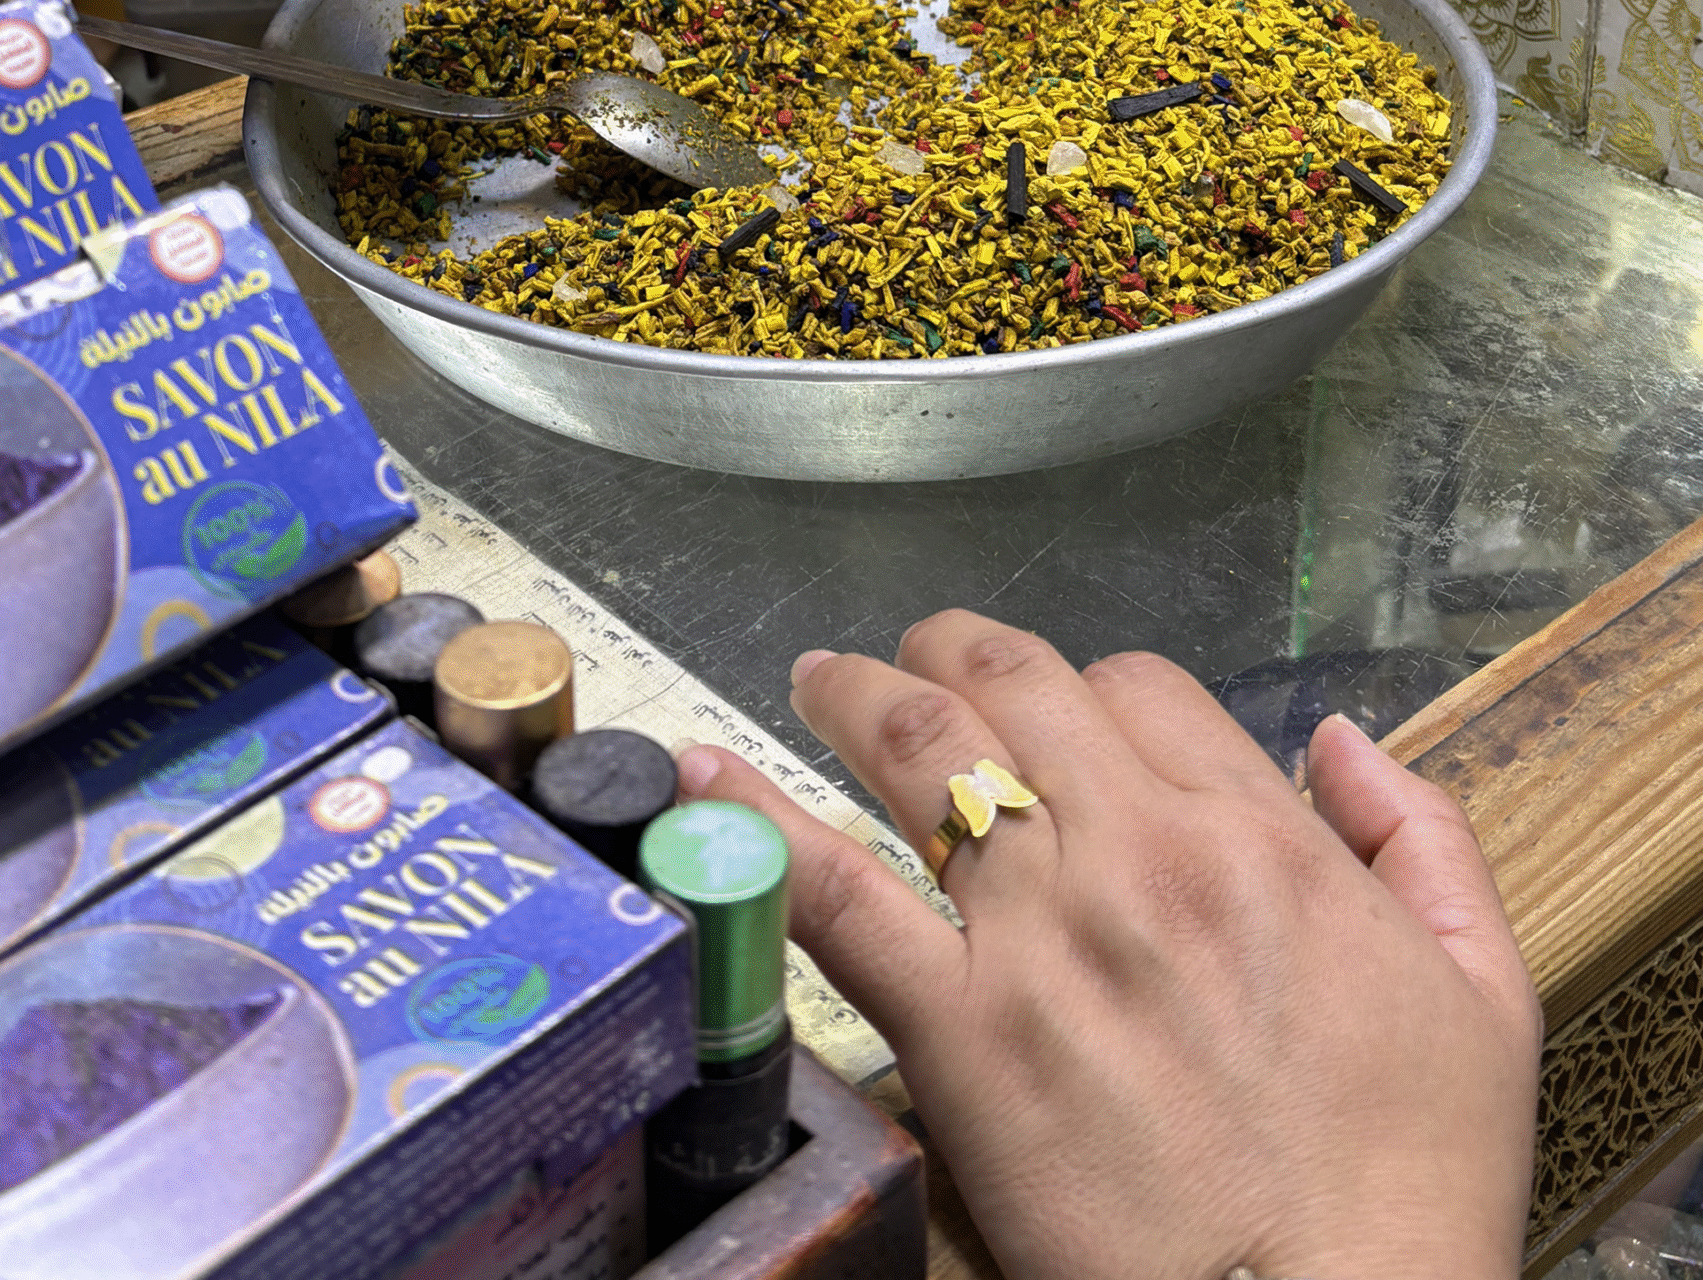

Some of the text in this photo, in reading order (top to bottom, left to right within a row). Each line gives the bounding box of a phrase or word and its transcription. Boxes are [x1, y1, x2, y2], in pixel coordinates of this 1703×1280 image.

[0, 76, 91, 136] صابون
[0, 122, 113, 217] VON
[80, 267, 272, 368] صابون بالنيلة
[112, 314, 303, 442] SAVON
[133, 367, 345, 506] au NILA
[348, 794, 450, 870] صابون
[300, 822, 499, 967] SAVON
[338, 853, 559, 1008] au NILA
